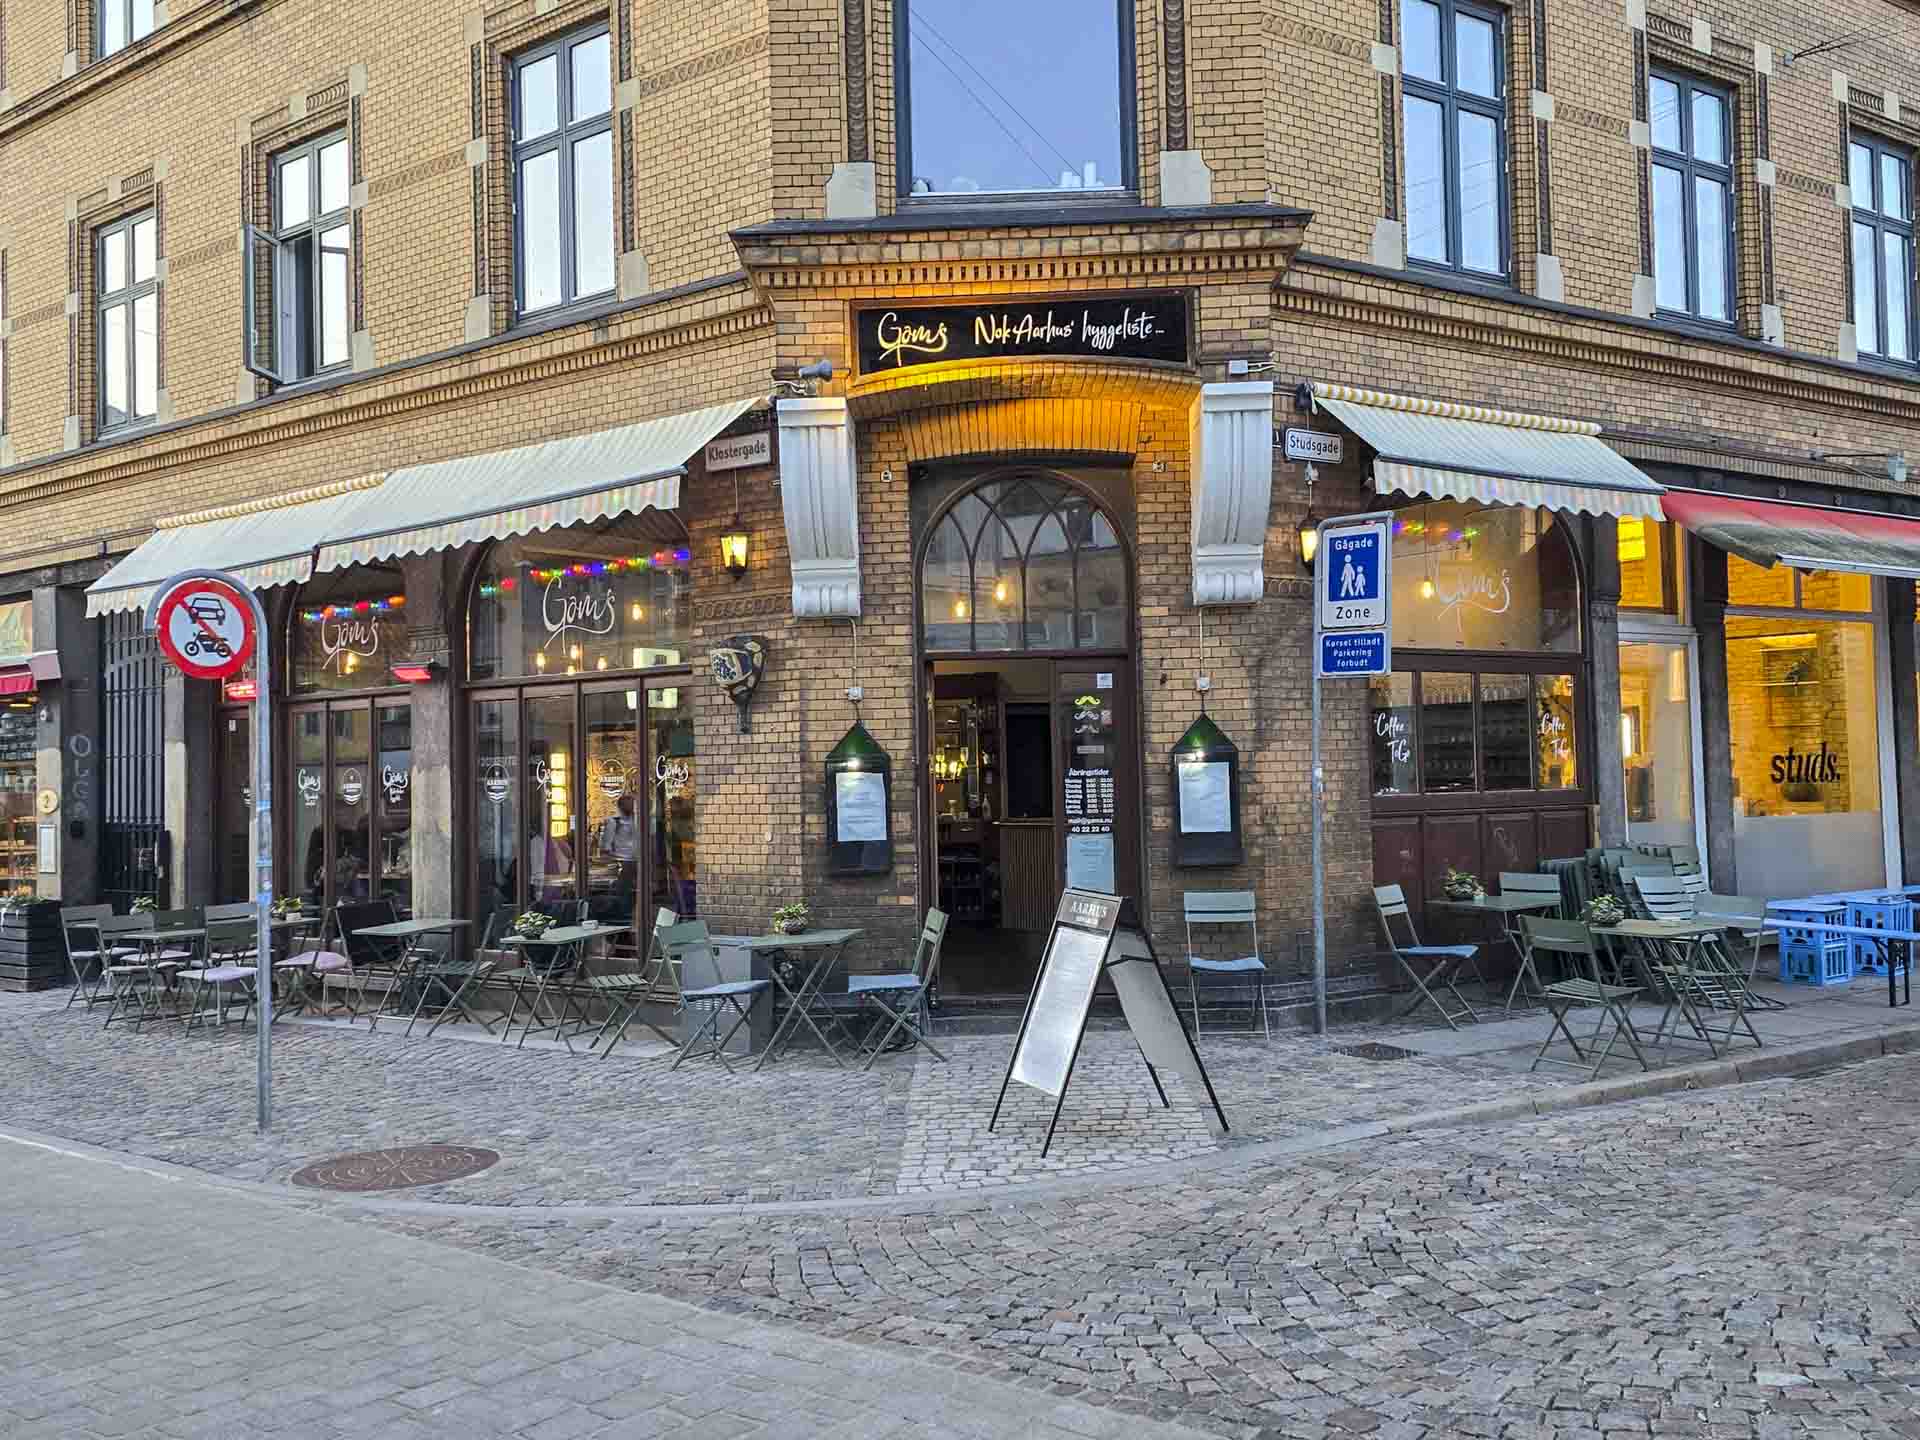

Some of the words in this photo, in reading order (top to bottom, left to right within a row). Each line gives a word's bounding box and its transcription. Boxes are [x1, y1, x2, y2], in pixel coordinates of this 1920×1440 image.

[974, 313, 1011, 345] Nok
[708, 440, 767, 462] Klostergade
[1289, 434, 1339, 456] Studsgade
[1334, 537, 1374, 551] Gågade
[1335, 605, 1371, 620] Zone
[1332, 648, 1373, 658] Parkering
[1336, 658, 1369, 668] forbudt
